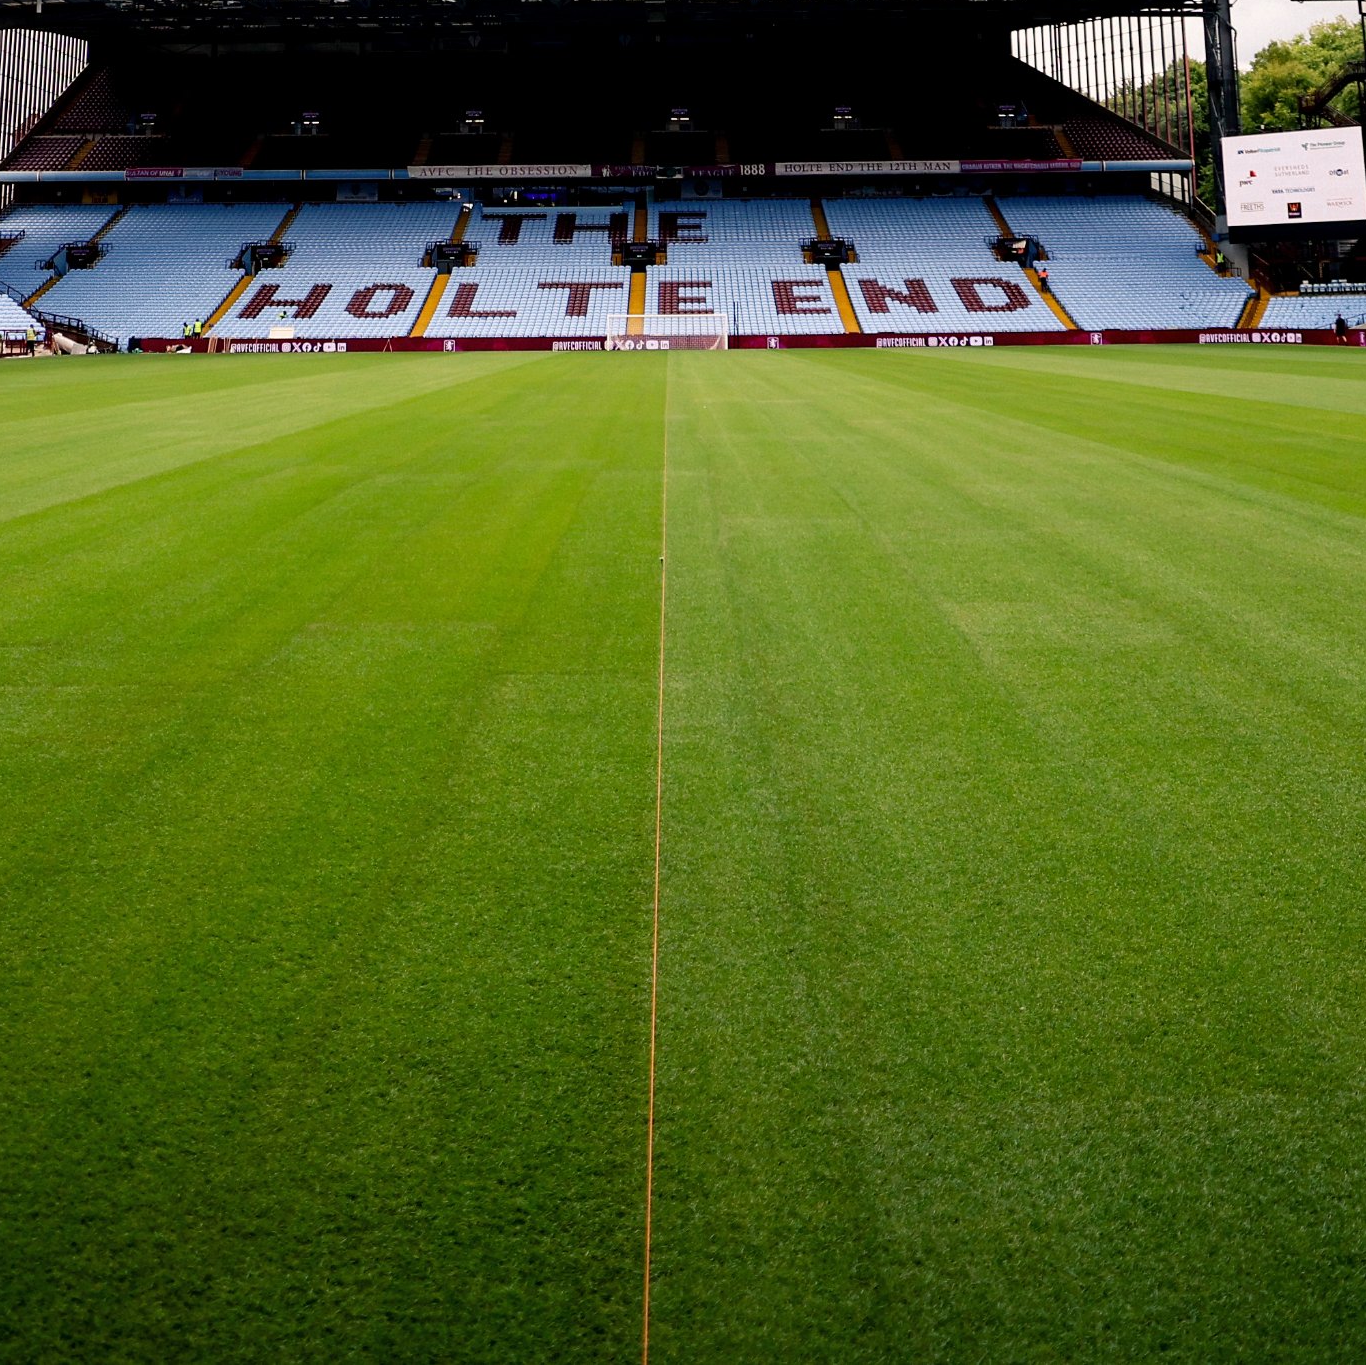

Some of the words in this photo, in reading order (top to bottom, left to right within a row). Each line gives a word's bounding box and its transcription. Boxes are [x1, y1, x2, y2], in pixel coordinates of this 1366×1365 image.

[419, 167, 454, 176] AVFC
[466, 167, 493, 176] THE
[499, 166, 578, 176] OBSESSION
[740, 164, 766, 176] 1888
[784, 164, 822, 172] HOLTE
[829, 163, 854, 171] END
[858, 163, 883, 171] THE
[889, 162, 917, 171] 12TH
[924, 162, 951, 170] MAN
[481, 212, 708, 244] THE
[238, 280, 714, 319] HOLTE
[771, 277, 1032, 315] END
[876, 337, 927, 348] @AVFCOFFICIAL
[1198, 333, 1251, 344] @AVFCOFFICIAL
[552, 340, 602, 351] @AVFCOFFICIAL
